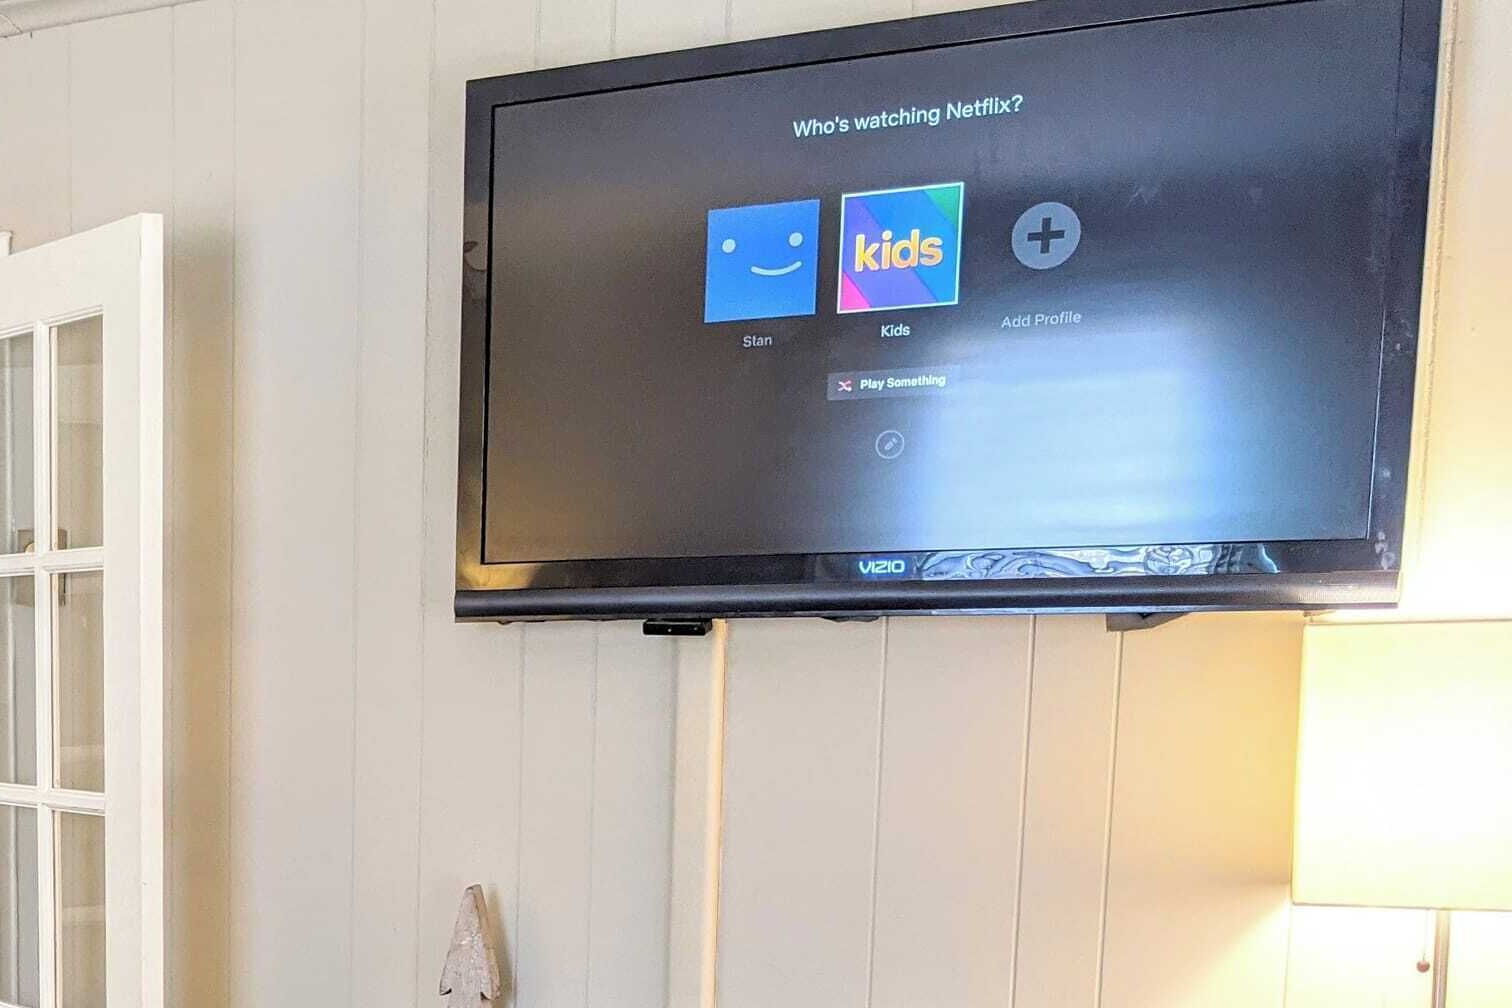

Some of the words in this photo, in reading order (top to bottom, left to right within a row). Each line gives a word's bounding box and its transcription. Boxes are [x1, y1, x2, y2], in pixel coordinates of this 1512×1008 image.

[792, 115, 850, 138] Who's
[854, 107, 941, 131] watching
[945, 94, 1024, 120] Netflix?
[854, 228, 944, 273] kids
[1000, 313, 1031, 329] Add
[1034, 310, 1083, 326] Profile
[880, 323, 912, 338] Kids
[742, 334, 773, 348] Stan
[859, 377, 885, 392] Play
[886, 374, 947, 389] Something
[858, 559, 905, 575] VIZIO
